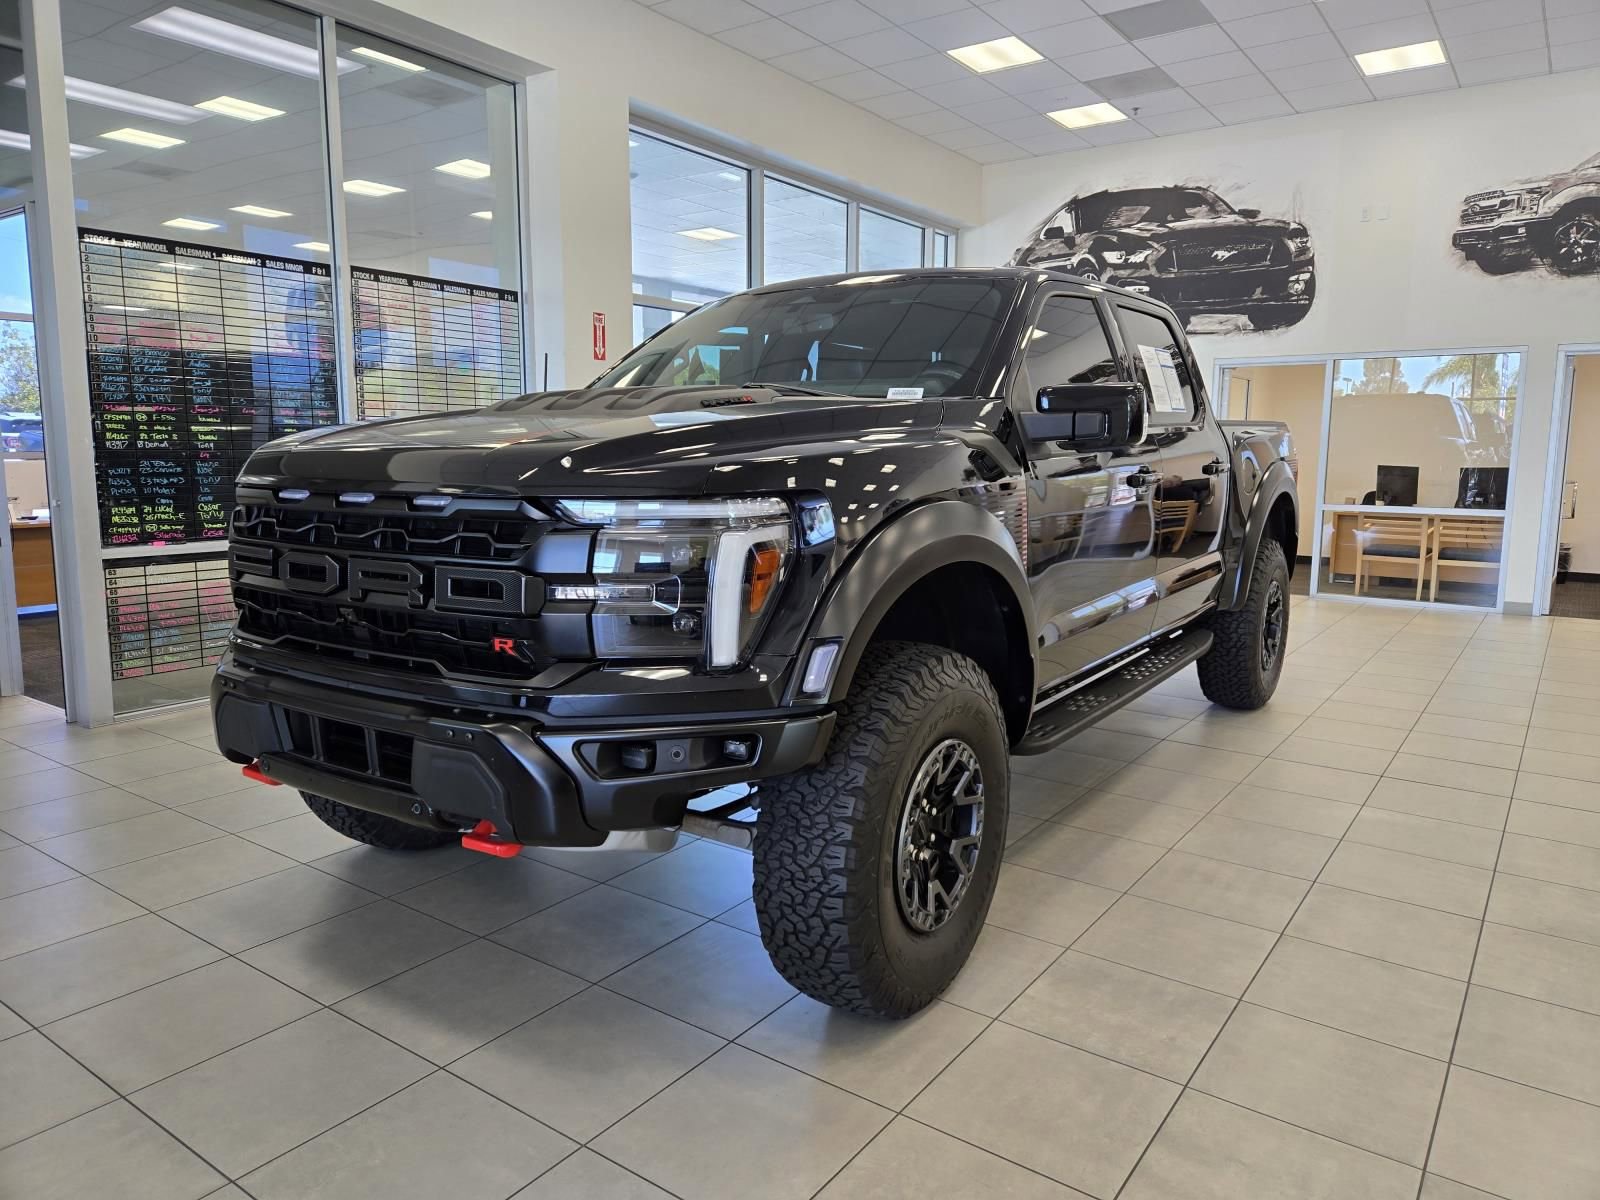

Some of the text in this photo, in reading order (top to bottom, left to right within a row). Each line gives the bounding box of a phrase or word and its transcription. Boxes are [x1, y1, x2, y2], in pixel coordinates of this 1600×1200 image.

[84, 234, 108, 244] STOCK
[175, 246, 211, 259] SALESMAN
[222, 253, 255, 266] SALESMAN
[265, 260, 285, 270] SALES
[285, 263, 304, 273] MNGR
[353, 272, 369, 280] STOCK
[229, 543, 542, 618] FORD
[492, 637, 517, 657] R
